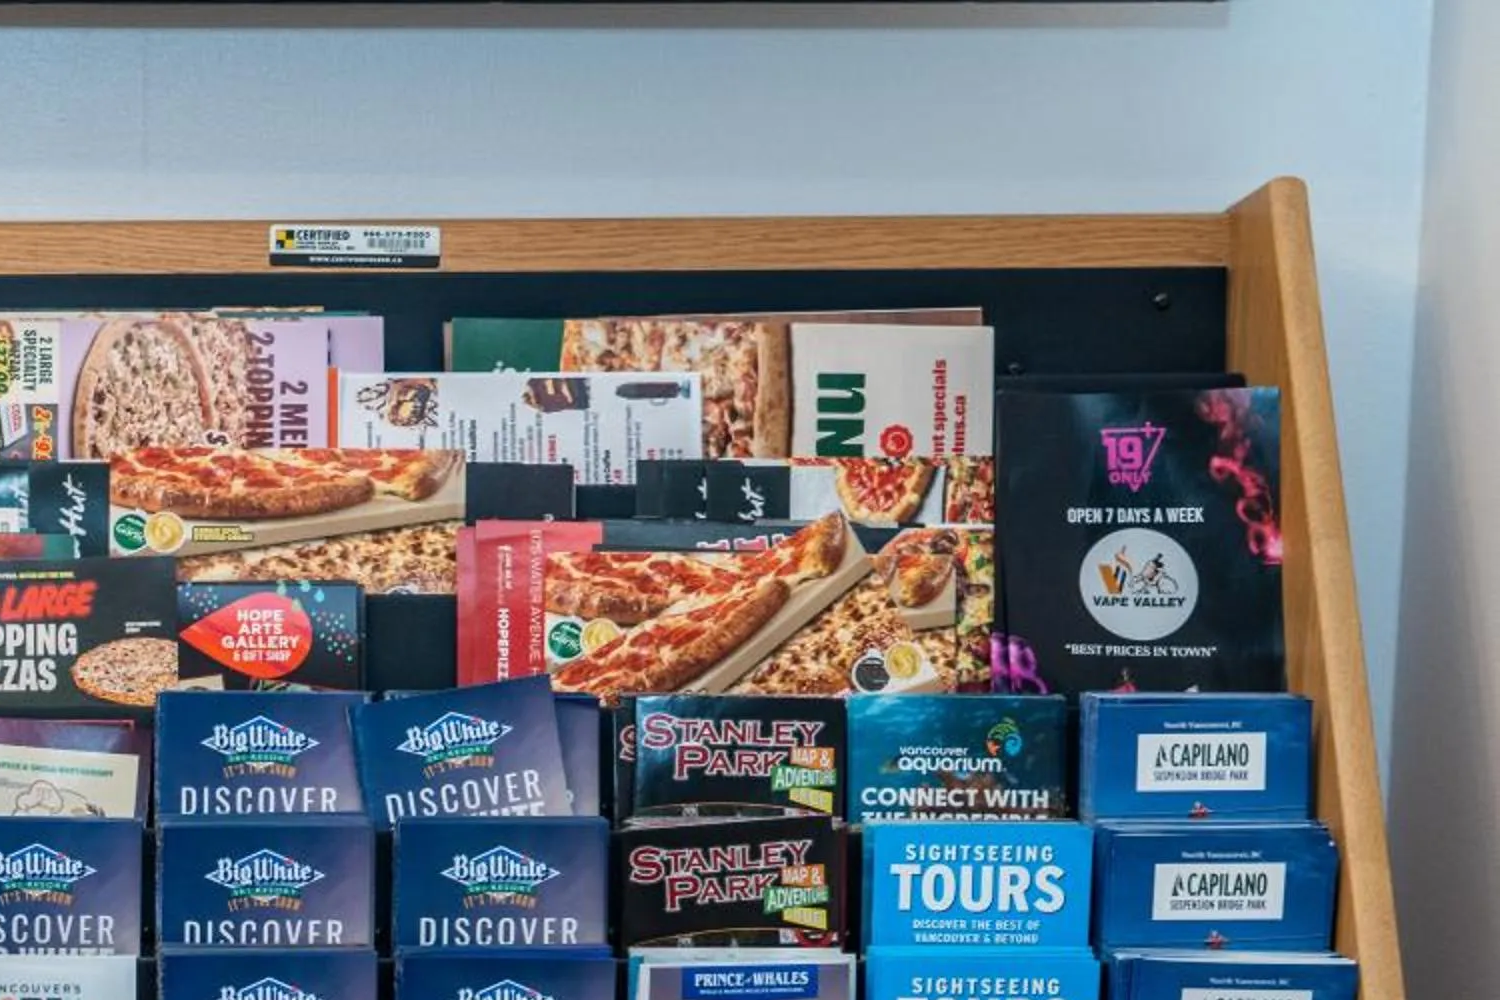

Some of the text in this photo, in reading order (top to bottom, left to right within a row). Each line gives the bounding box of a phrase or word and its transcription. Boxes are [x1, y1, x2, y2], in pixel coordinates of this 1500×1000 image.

[297, 230, 350, 241] CERTIFIED
[932, 359, 947, 431] specials
[1109, 471, 1152, 484] ONLY
[1067, 508, 1204, 523] OPEN 7 DAYS A WEEK
[0, 580, 98, 621] LARGE
[1093, 596, 1187, 608] VAPE VALLEY
[236, 609, 286, 622] HOPE
[238, 623, 284, 635] ARTS
[221, 636, 300, 649] GALLERY
[1105, 645, 1151, 656] PRICES
[1153, 647, 1167, 656] IN
[266, 651, 291, 662] SHOP
[213, 724, 306, 751] Big White
[644, 712, 825, 749] STANLEY
[900, 747, 969, 756] vancouver
[1170, 744, 1249, 767] CAPILANO
[673, 745, 786, 781] PARK
[898, 757, 1002, 775] aquarium
[1154, 771, 1248, 781] SUSPENSION BRIDGE PARK
[180, 786, 337, 814] DISCOVER
[385, 769, 544, 822] DISCOVER
[861, 787, 1049, 809] CONNECT WITH
[905, 844, 1053, 862] SIGHTSEEING
[25, 854, 83, 874] White
[890, 864, 1066, 913] TOURS
[1187, 873, 1268, 897] CAPILANO
[913, 919, 1040, 930] DISCOVER THE BEST OF
[915, 933, 980, 943] VANCOUVER
[995, 934, 1038, 944] BEYOND
[695, 971, 809, 988] PRINCE WHALES
